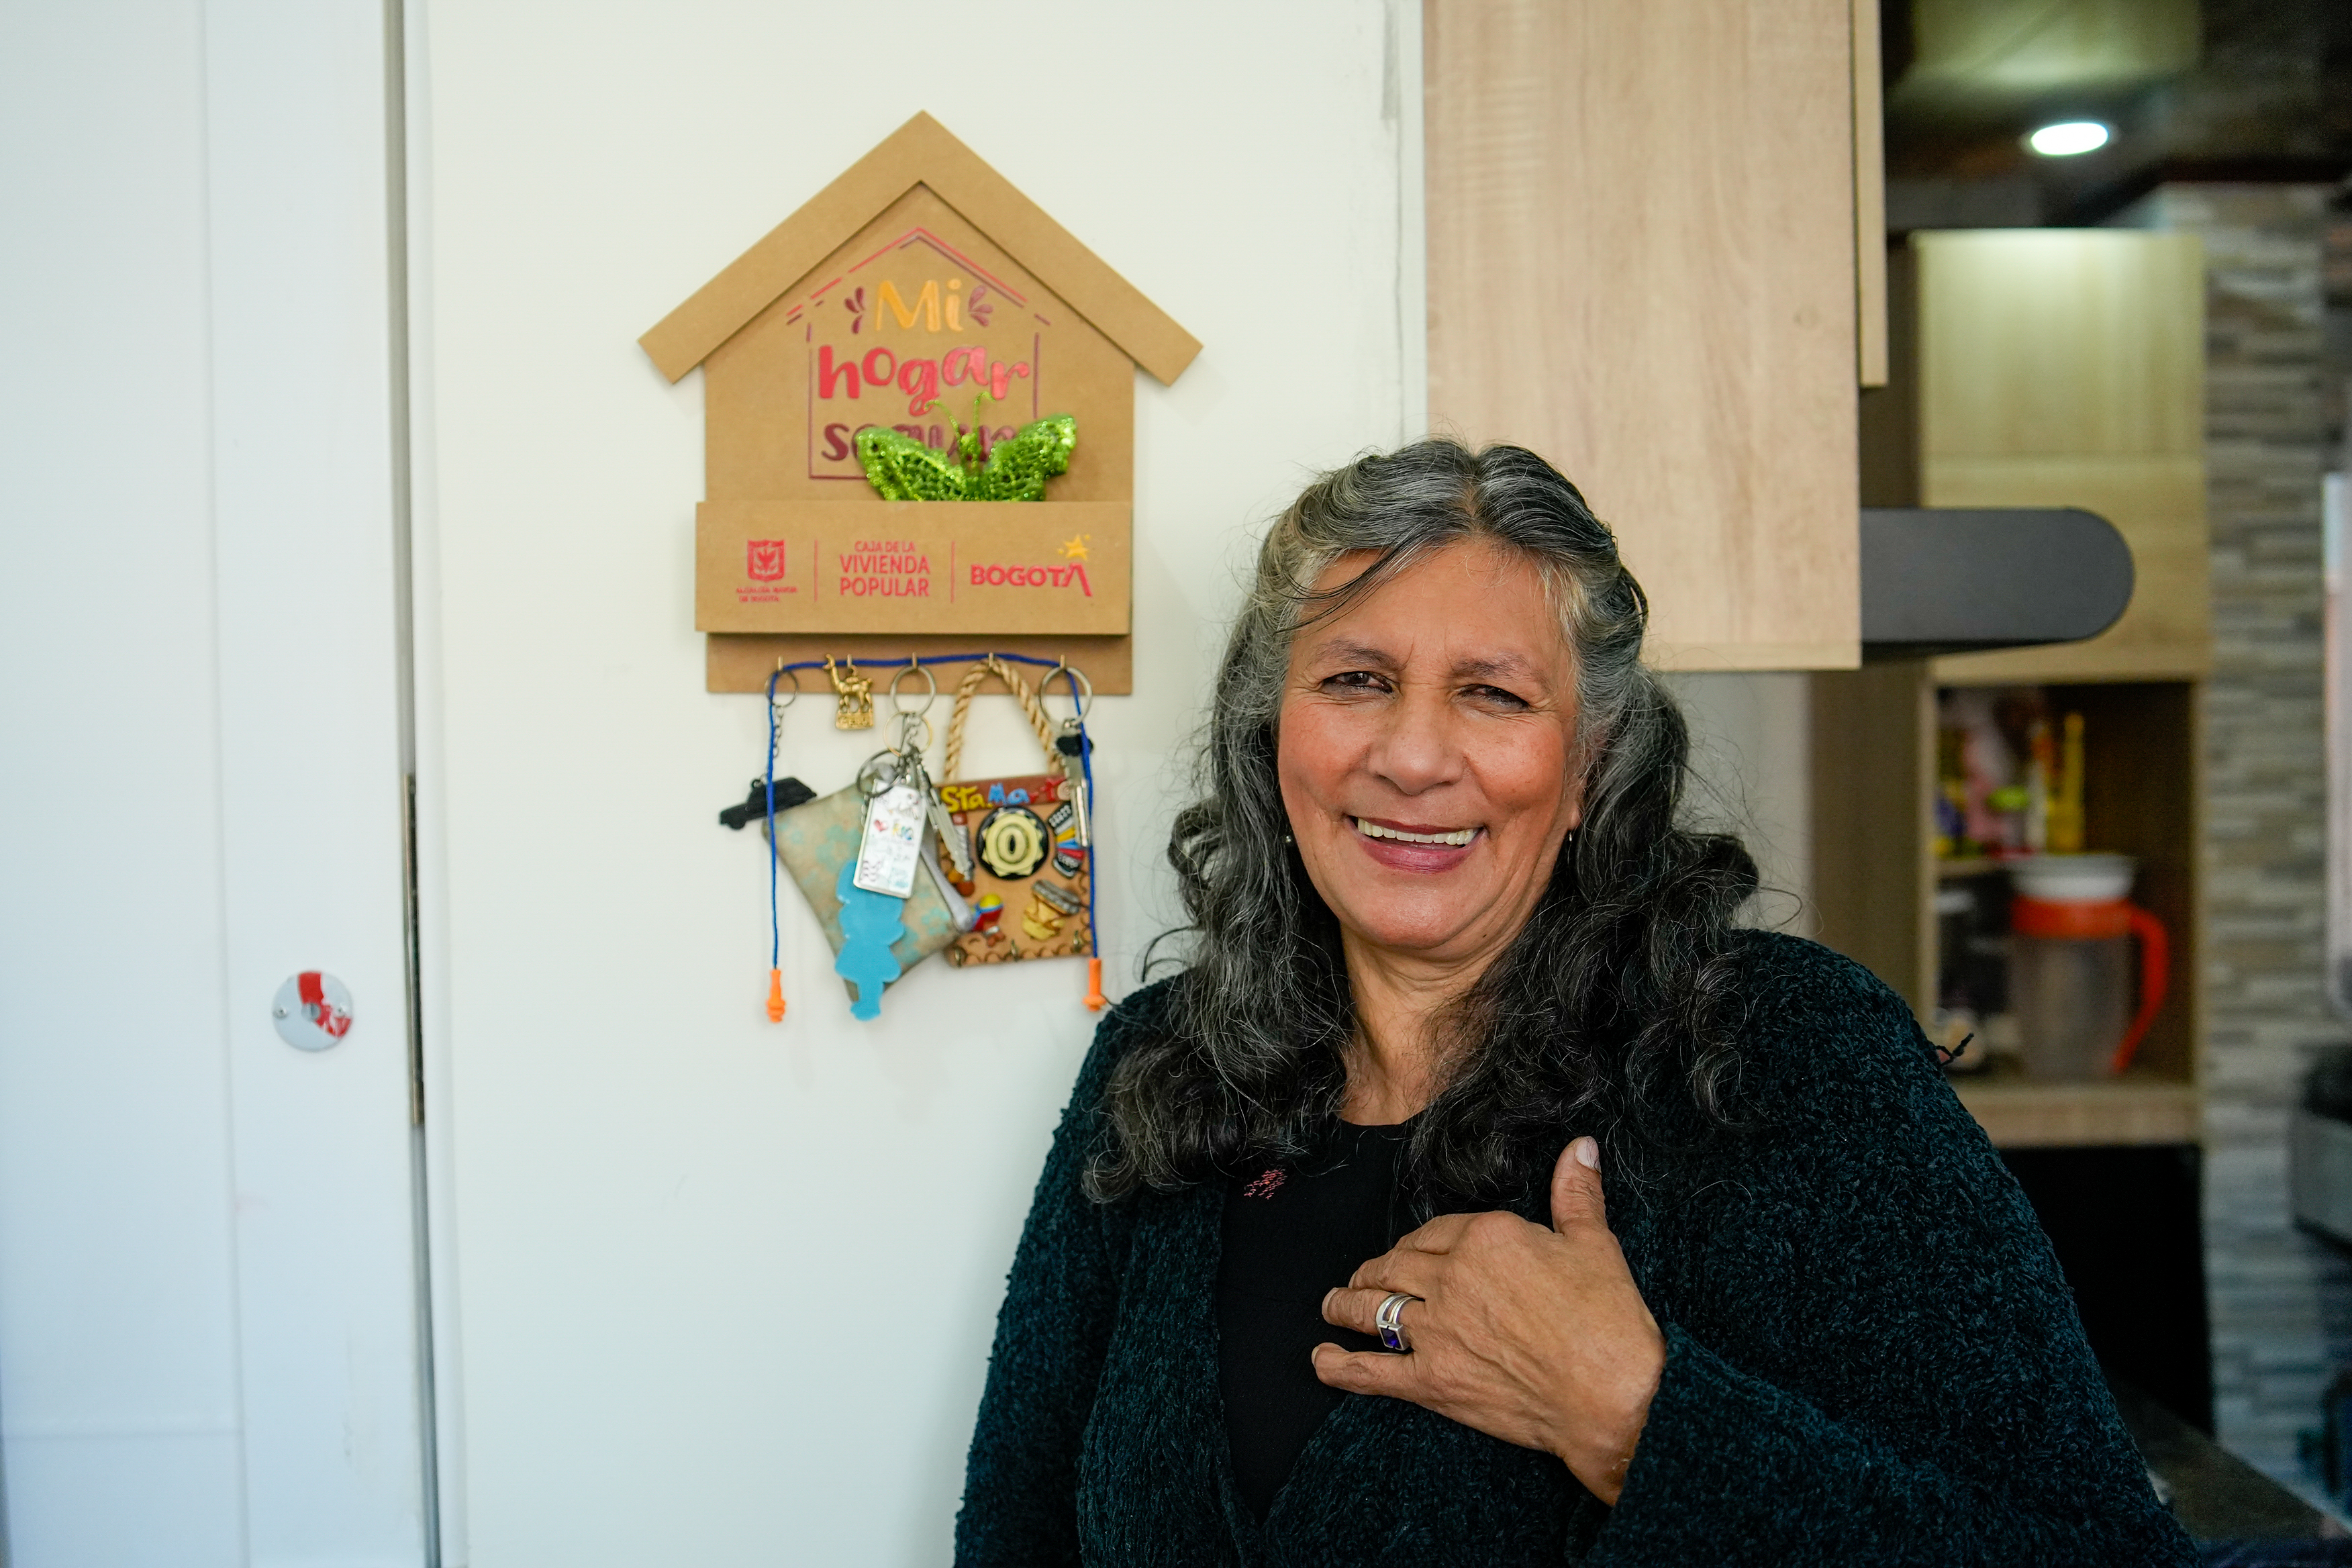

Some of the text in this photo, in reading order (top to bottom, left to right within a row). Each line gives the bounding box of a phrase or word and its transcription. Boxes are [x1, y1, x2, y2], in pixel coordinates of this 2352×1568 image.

[876, 279, 963, 332] Mi
[818, 345, 1030, 415] hogar
[854, 540, 916, 552] CAJA DE LA
[840, 554, 930, 574] VIVIENDA
[840, 577, 929, 596] POPULAR
